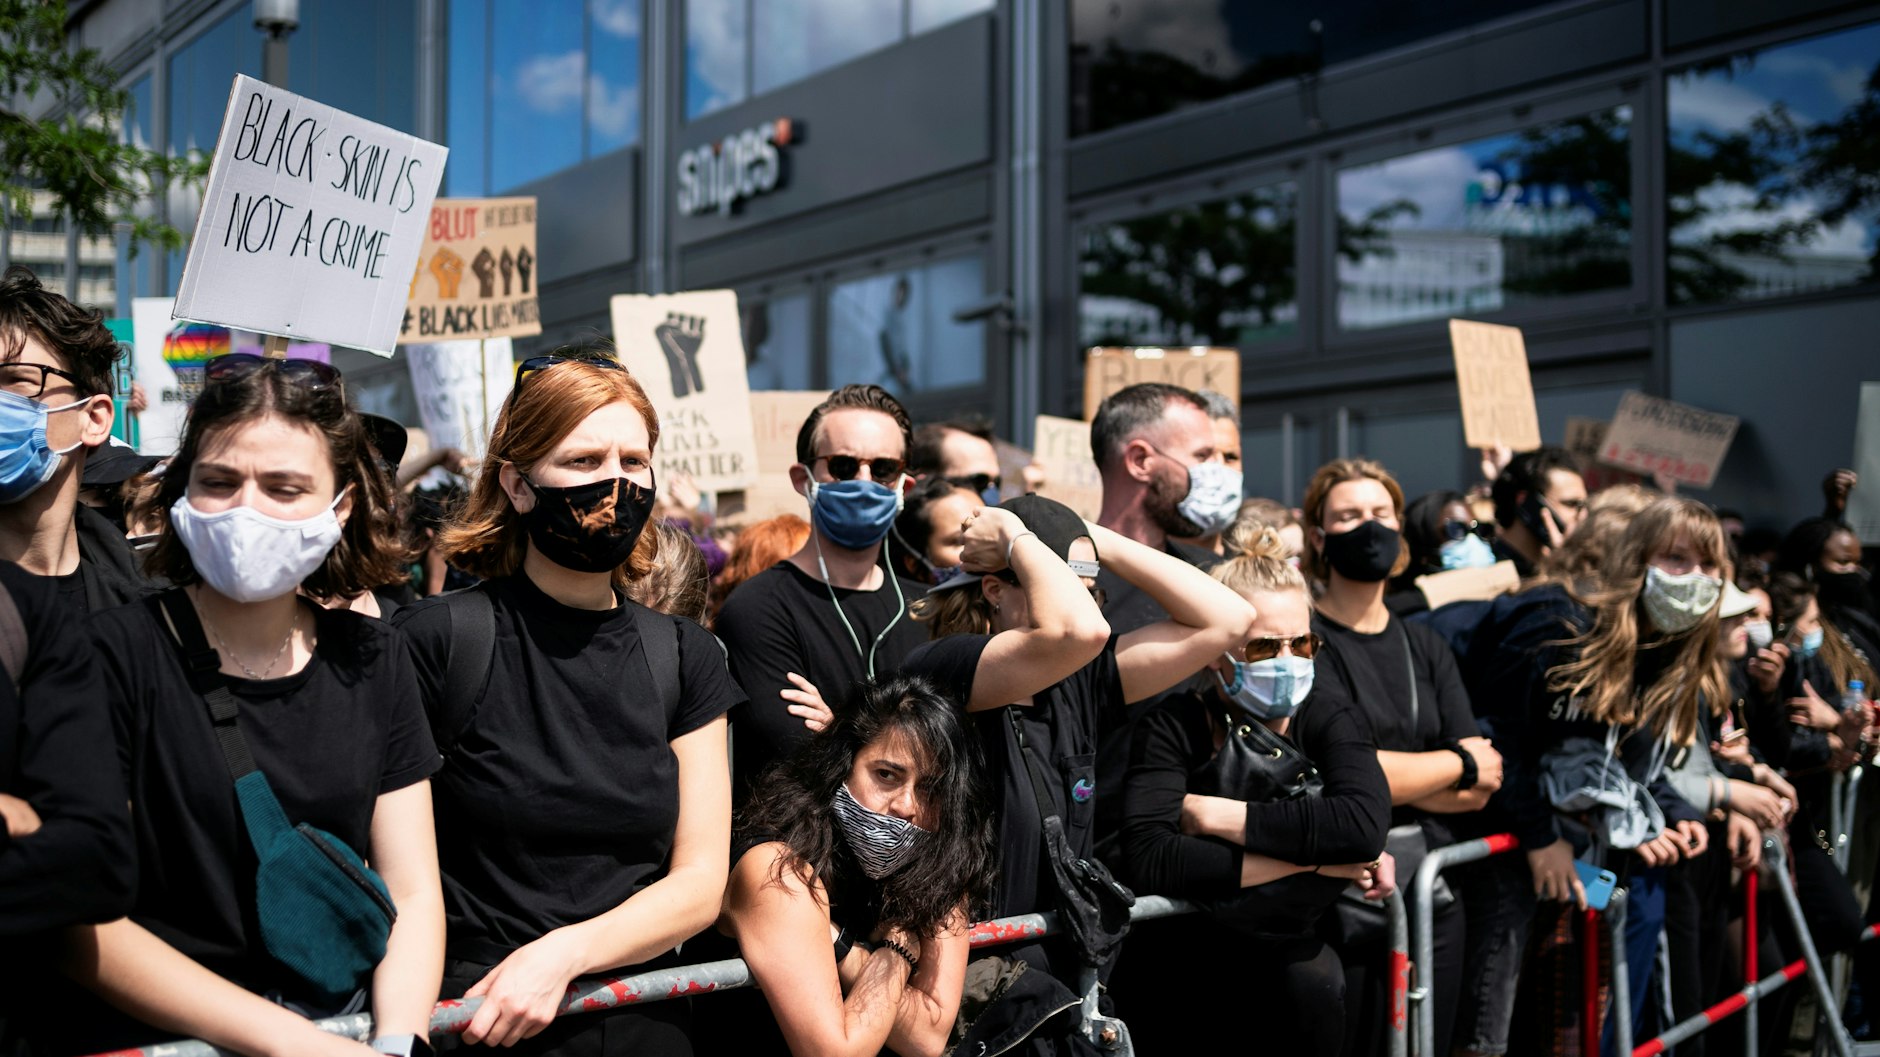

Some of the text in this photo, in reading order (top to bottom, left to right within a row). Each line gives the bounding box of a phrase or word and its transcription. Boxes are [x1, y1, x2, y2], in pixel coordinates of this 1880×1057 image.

[233, 92, 422, 213] BLACK SKIN IS
[224, 192, 391, 279] NOT A CRIME
[431, 206, 480, 242] BLUT
[419, 304, 479, 336] BLACK
[665, 407, 710, 429] ACK
[659, 430, 719, 453] LIVES
[660, 452, 745, 480] MATTER
